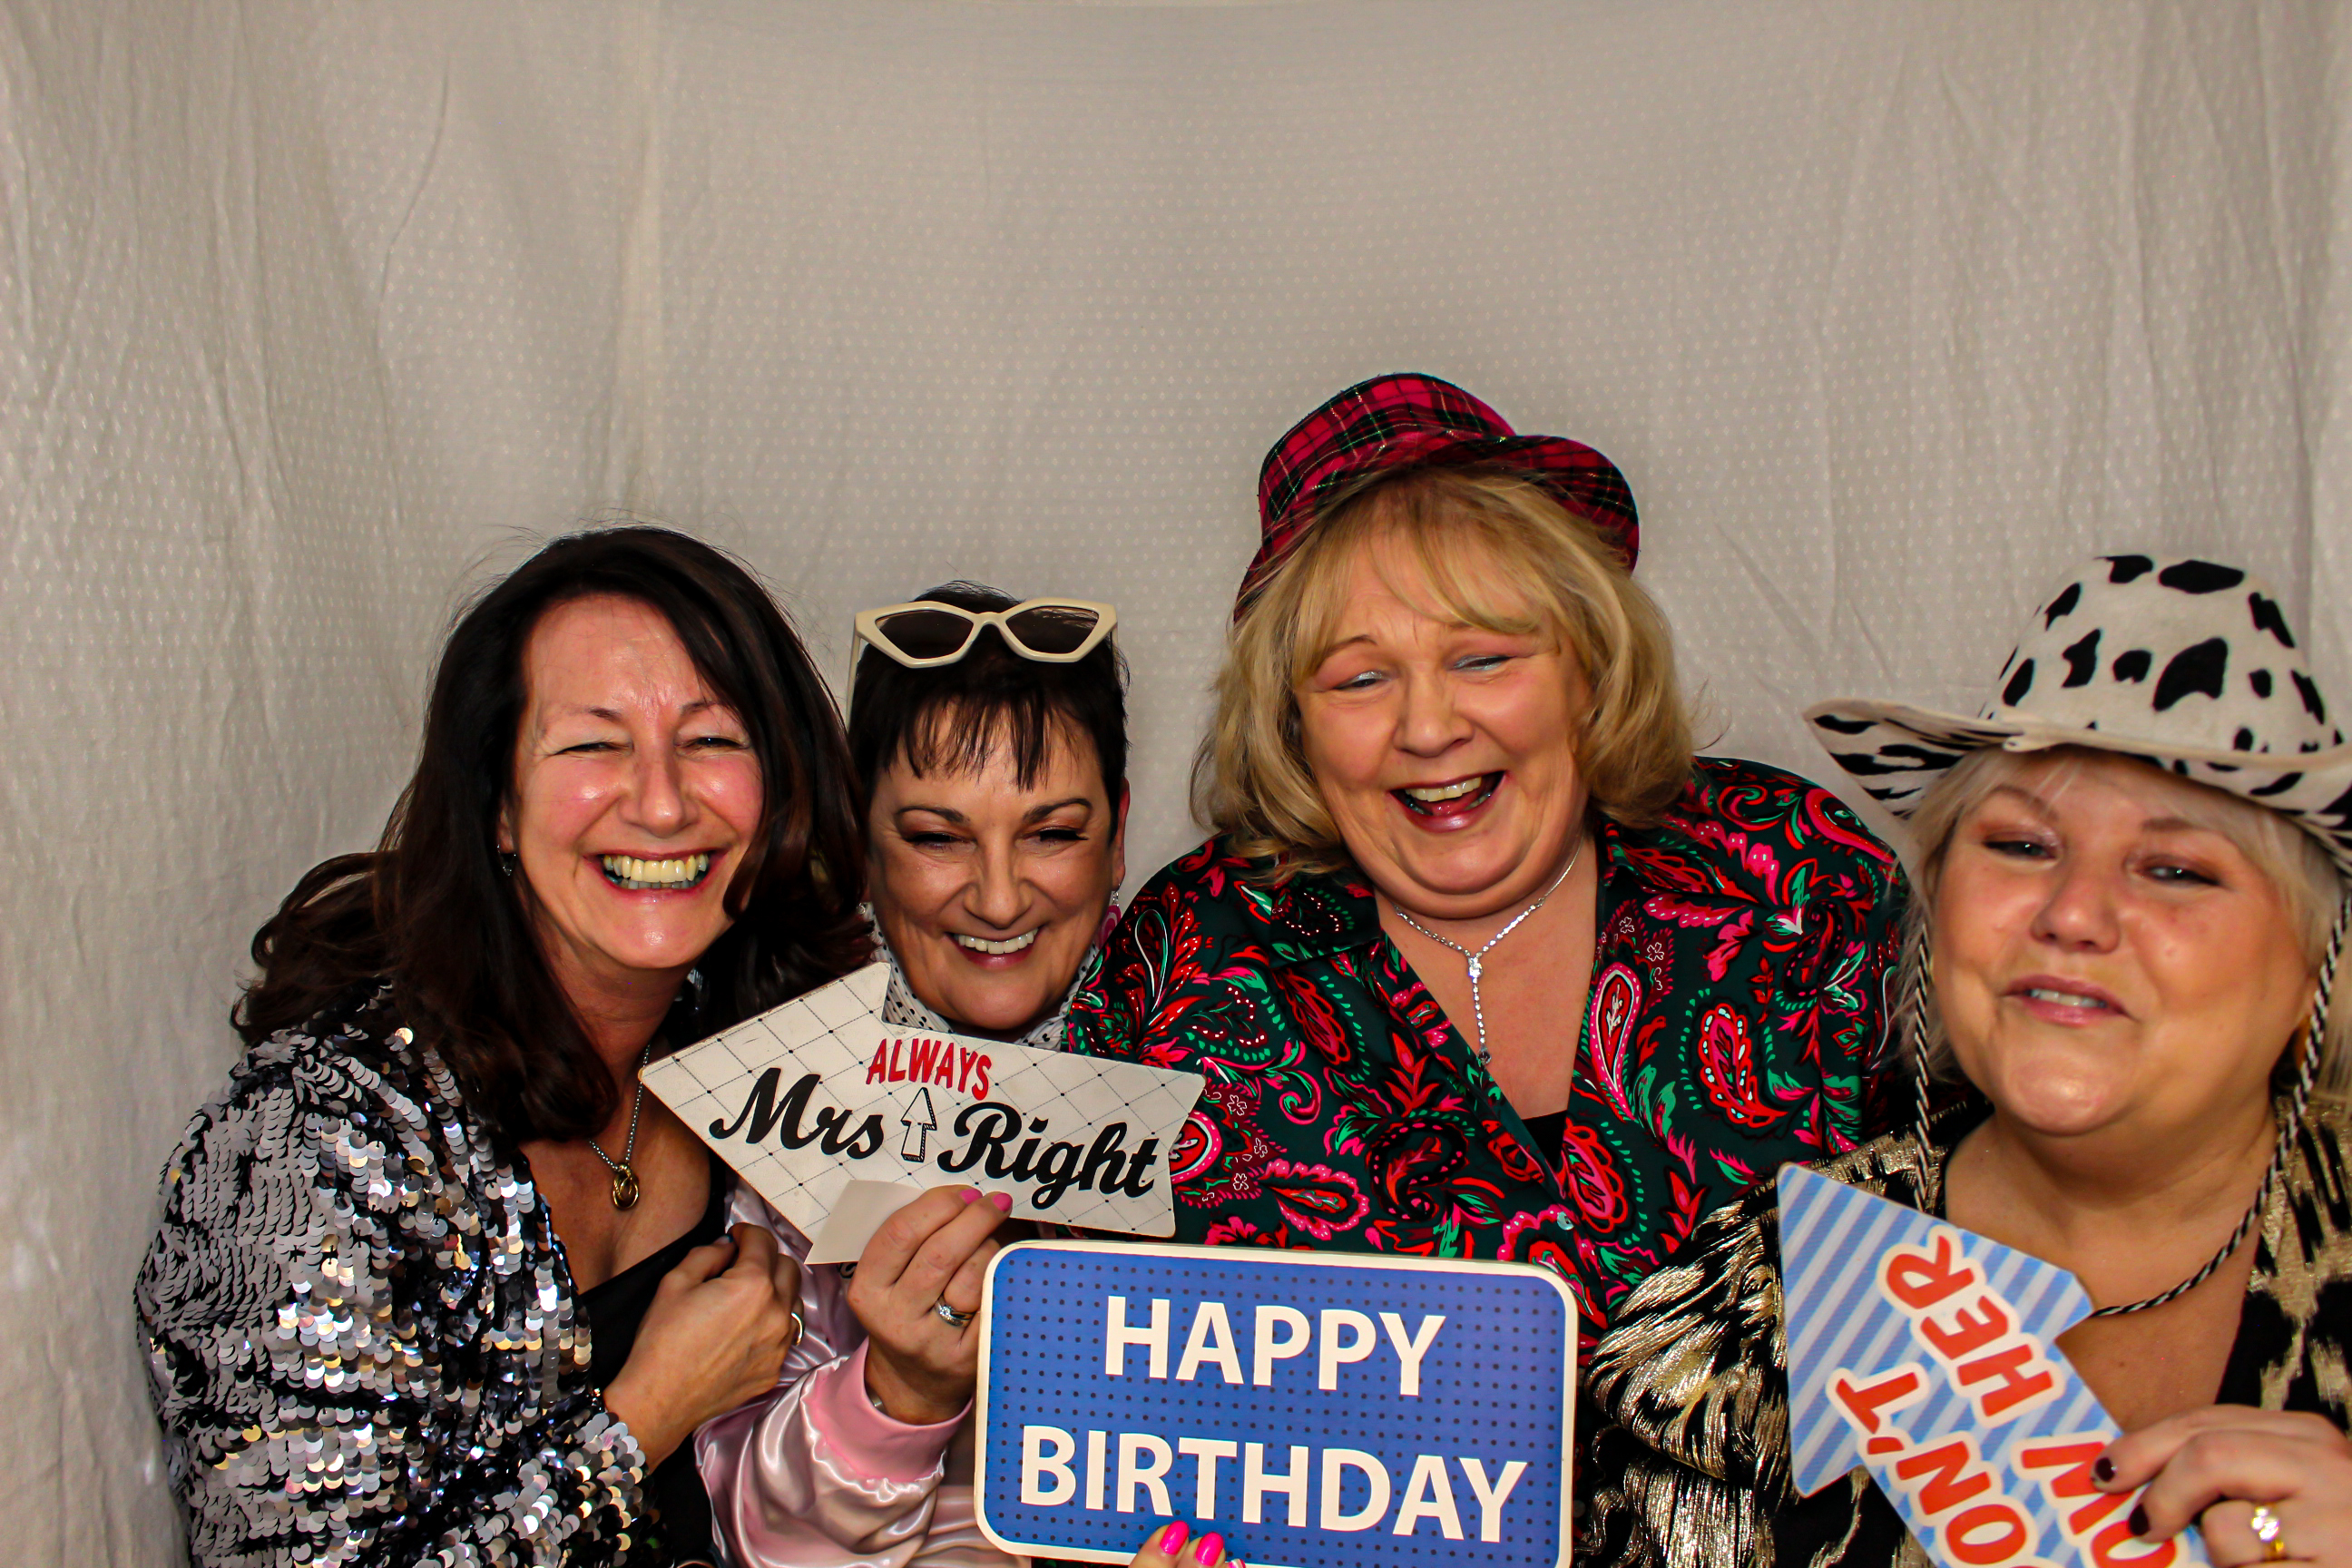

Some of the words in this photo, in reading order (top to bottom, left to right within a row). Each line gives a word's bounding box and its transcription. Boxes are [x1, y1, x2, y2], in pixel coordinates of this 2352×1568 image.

[866, 1038, 992, 1101] ALWAYS
[710, 1067, 885, 1160] Mrs
[936, 1102, 1159, 1210] Right
[1104, 1296, 1446, 1396] HAPPY
[1886, 1235, 2053, 1417] HER
[1020, 1425, 1528, 1543] BIRTHDAY
[1836, 1372, 2037, 1568] ON'T
